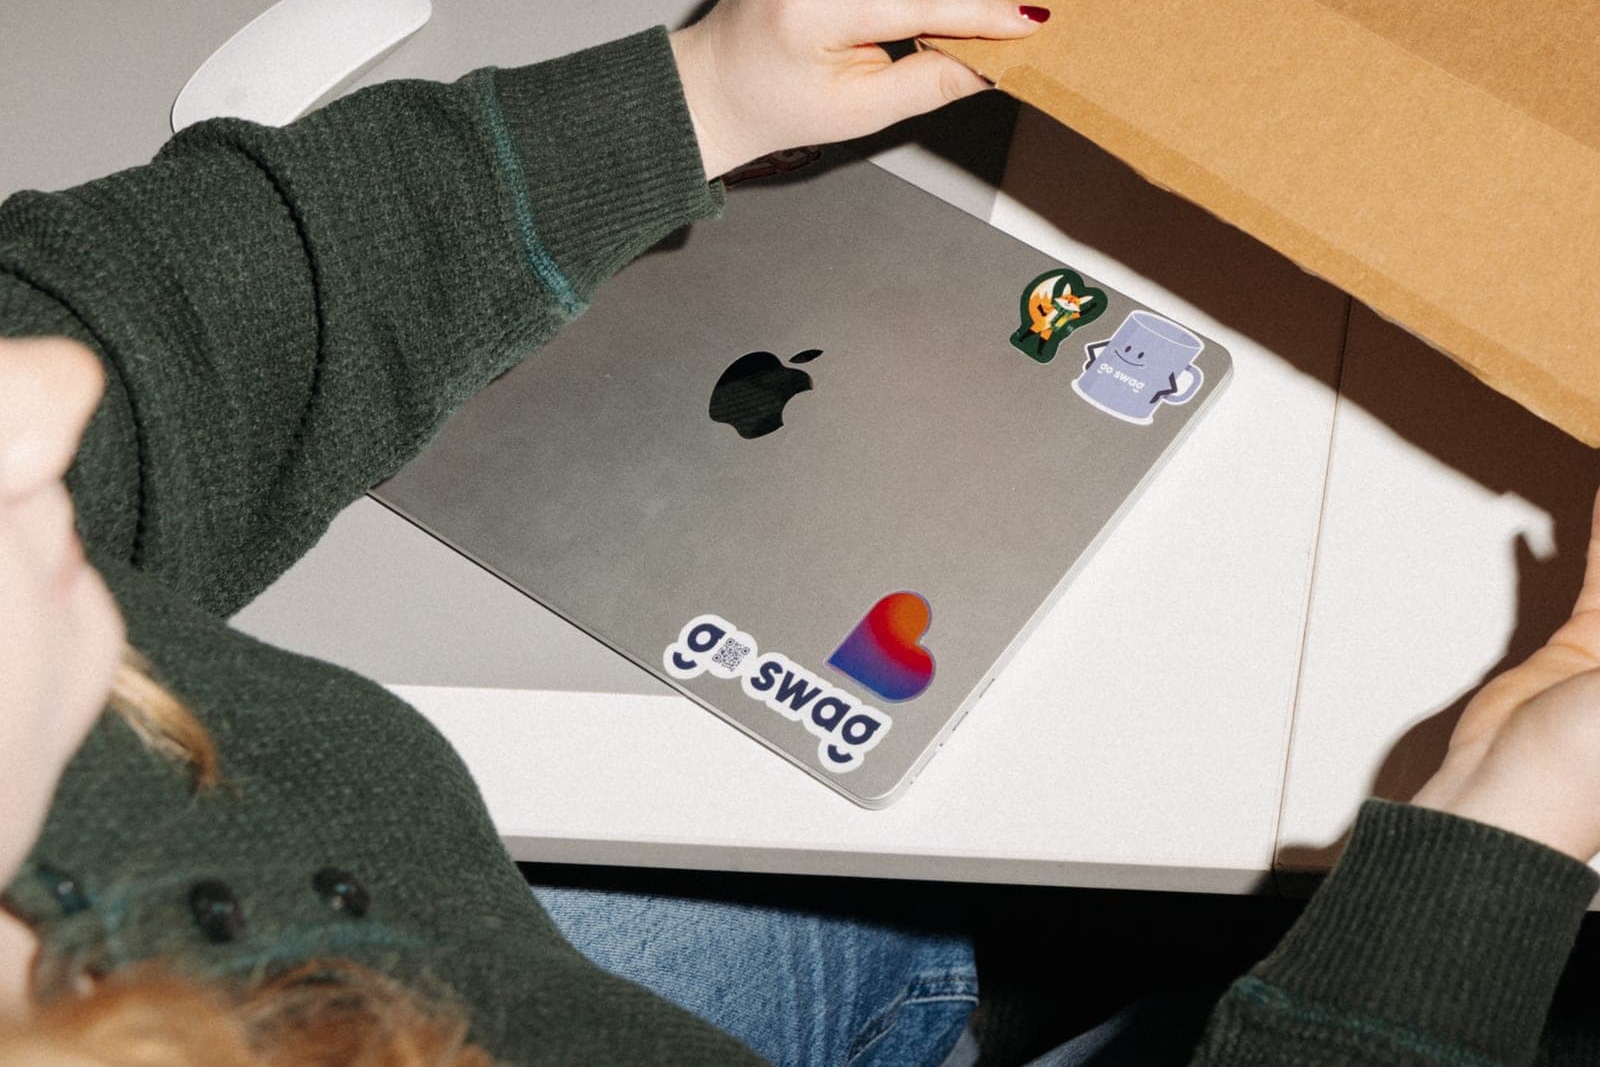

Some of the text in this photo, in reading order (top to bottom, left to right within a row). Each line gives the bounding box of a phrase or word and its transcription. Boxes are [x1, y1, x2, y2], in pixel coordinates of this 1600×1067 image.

[1097, 363, 1145, 393] go swag
[750, 661, 882, 763] swag
